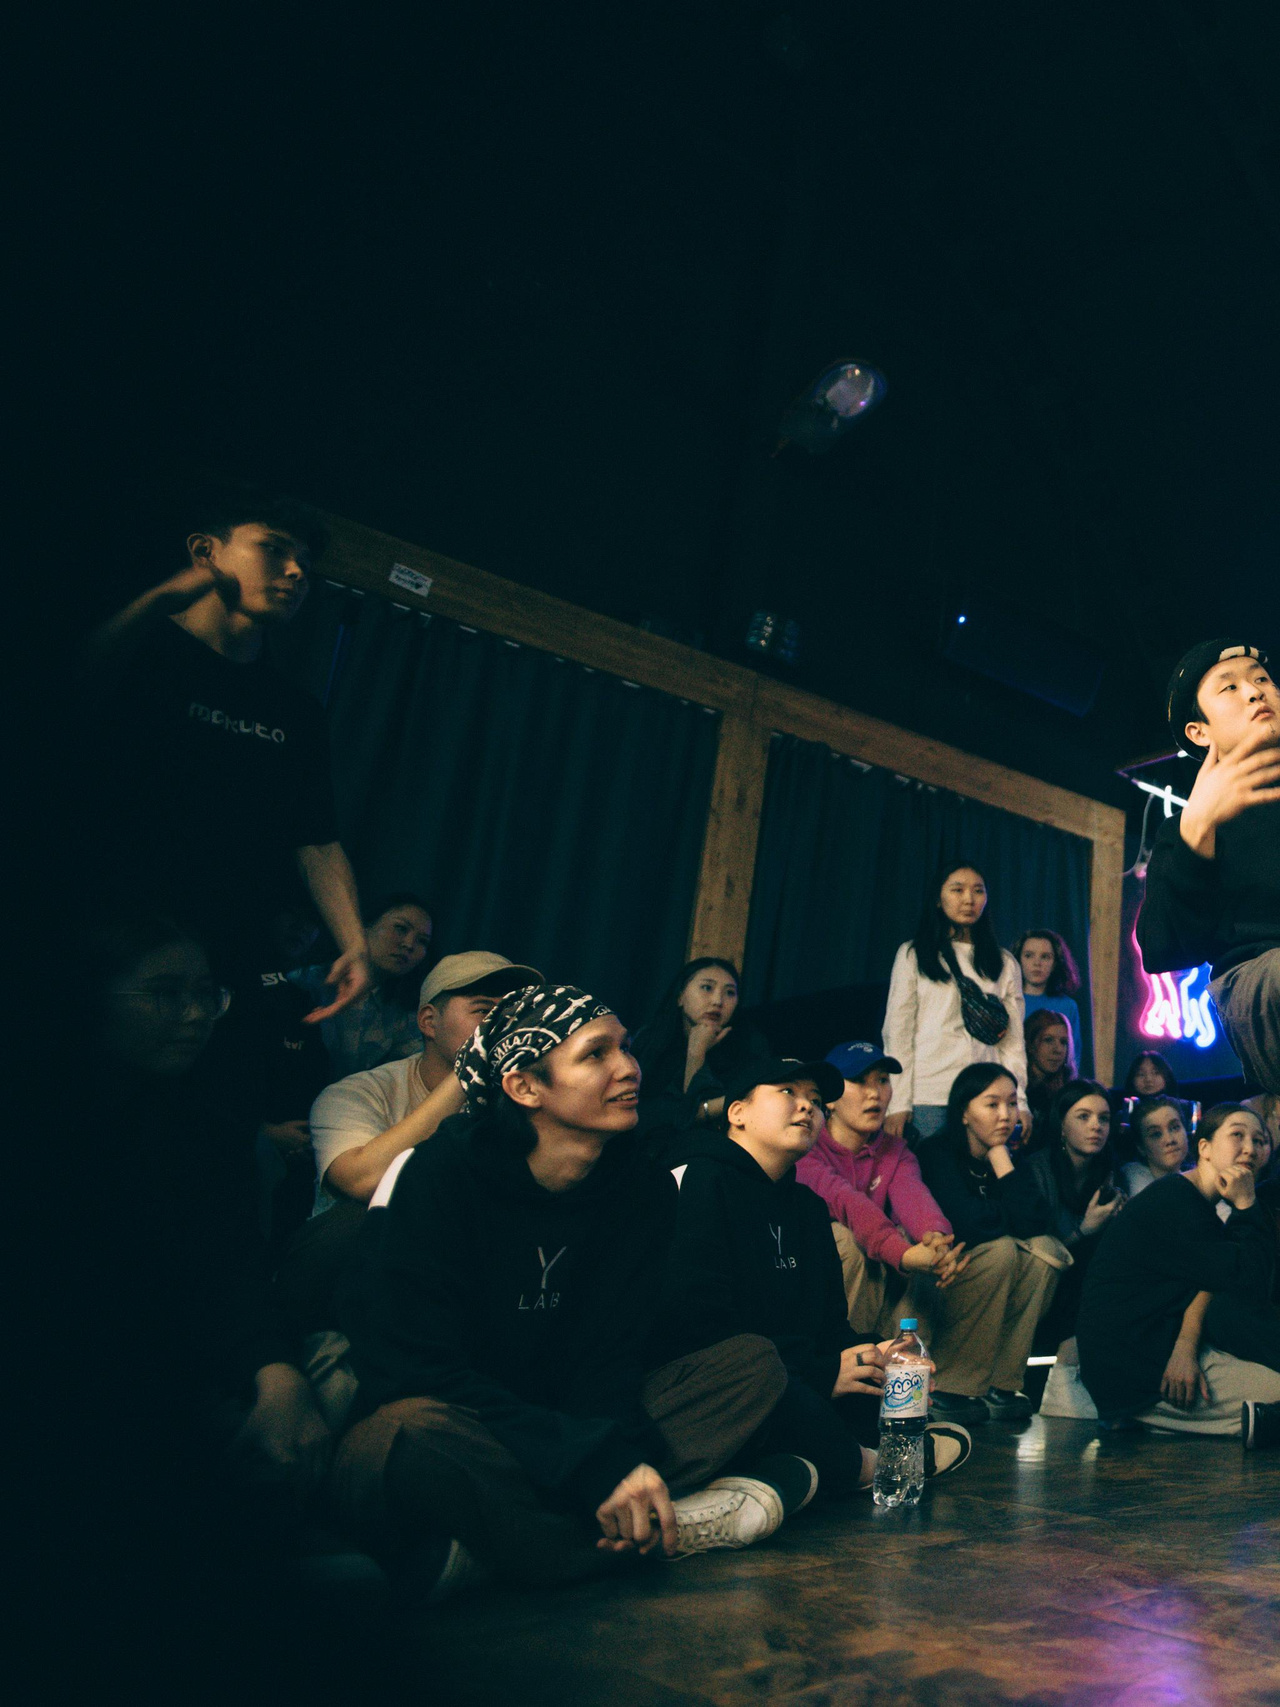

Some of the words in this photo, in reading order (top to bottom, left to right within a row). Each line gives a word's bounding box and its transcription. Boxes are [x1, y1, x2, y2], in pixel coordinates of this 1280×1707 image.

[537, 1246, 567, 1289] Y
[774, 1257, 797, 1269] LAB
[518, 1293, 560, 1310] LAB
